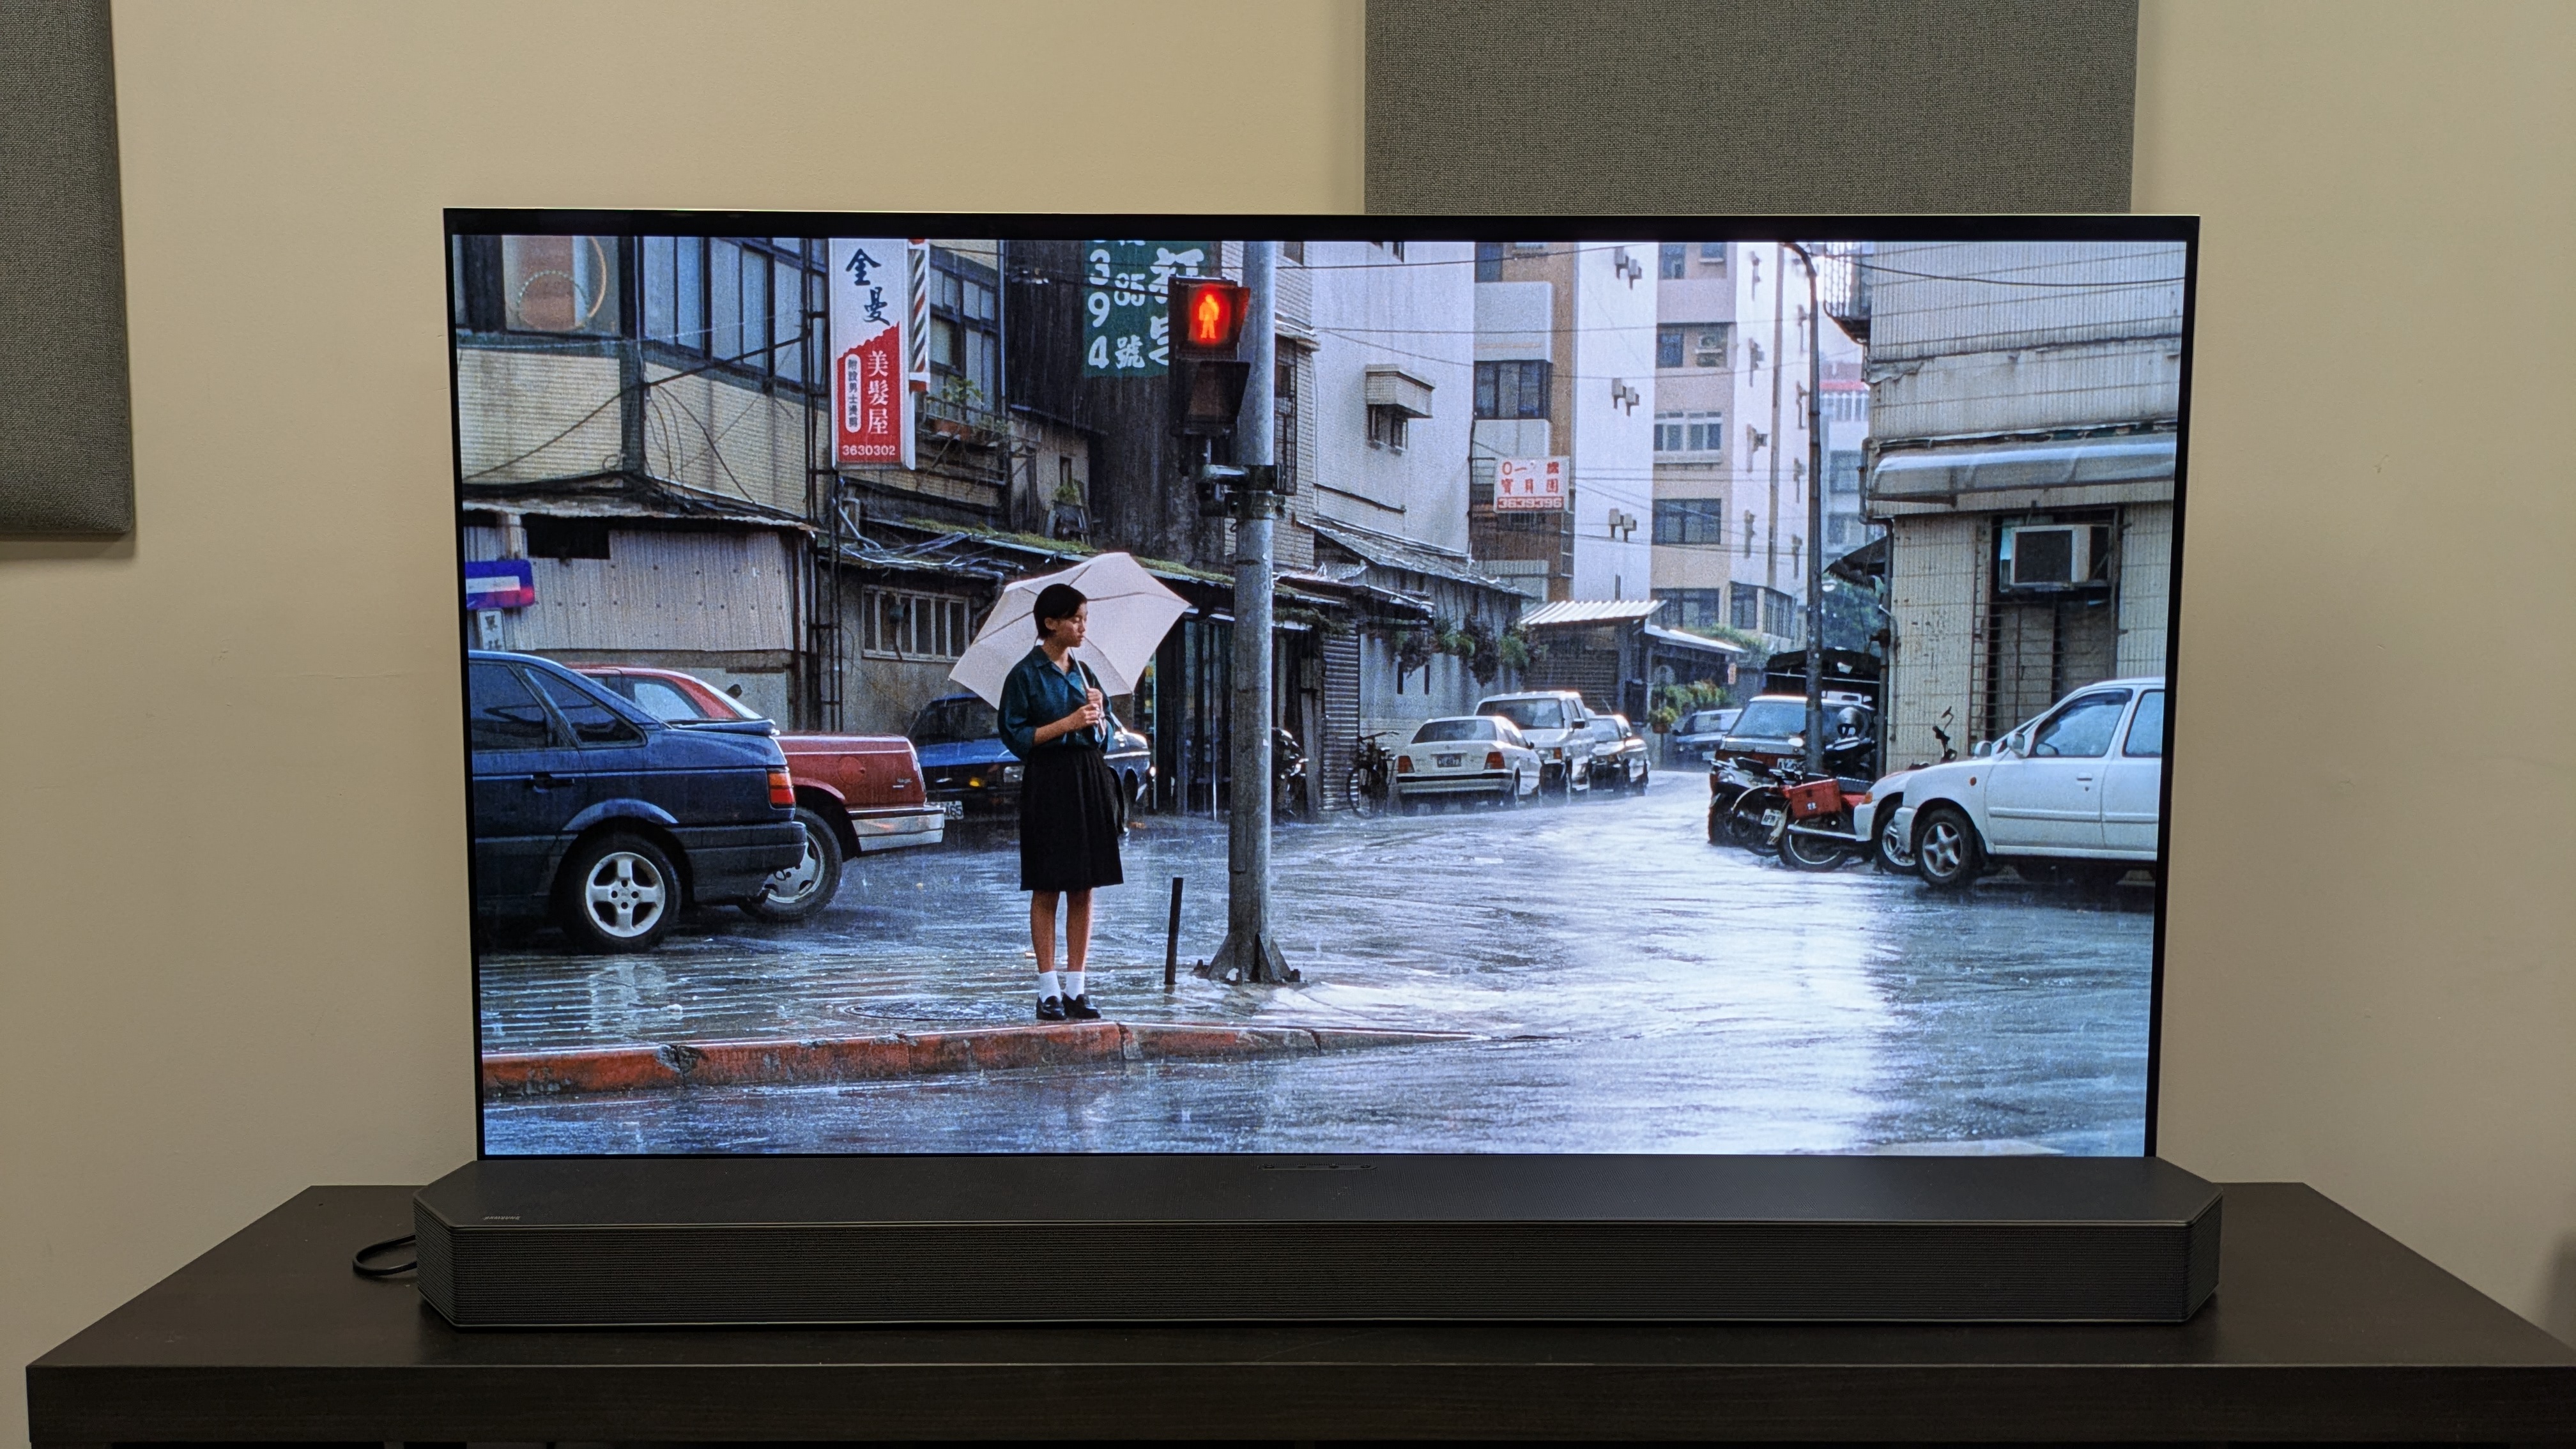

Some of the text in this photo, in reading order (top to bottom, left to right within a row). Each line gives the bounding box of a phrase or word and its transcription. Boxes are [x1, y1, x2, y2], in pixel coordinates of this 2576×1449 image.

[867, 350, 889, 435] 美髮屋
[842, 445, 896, 456] 3630302
